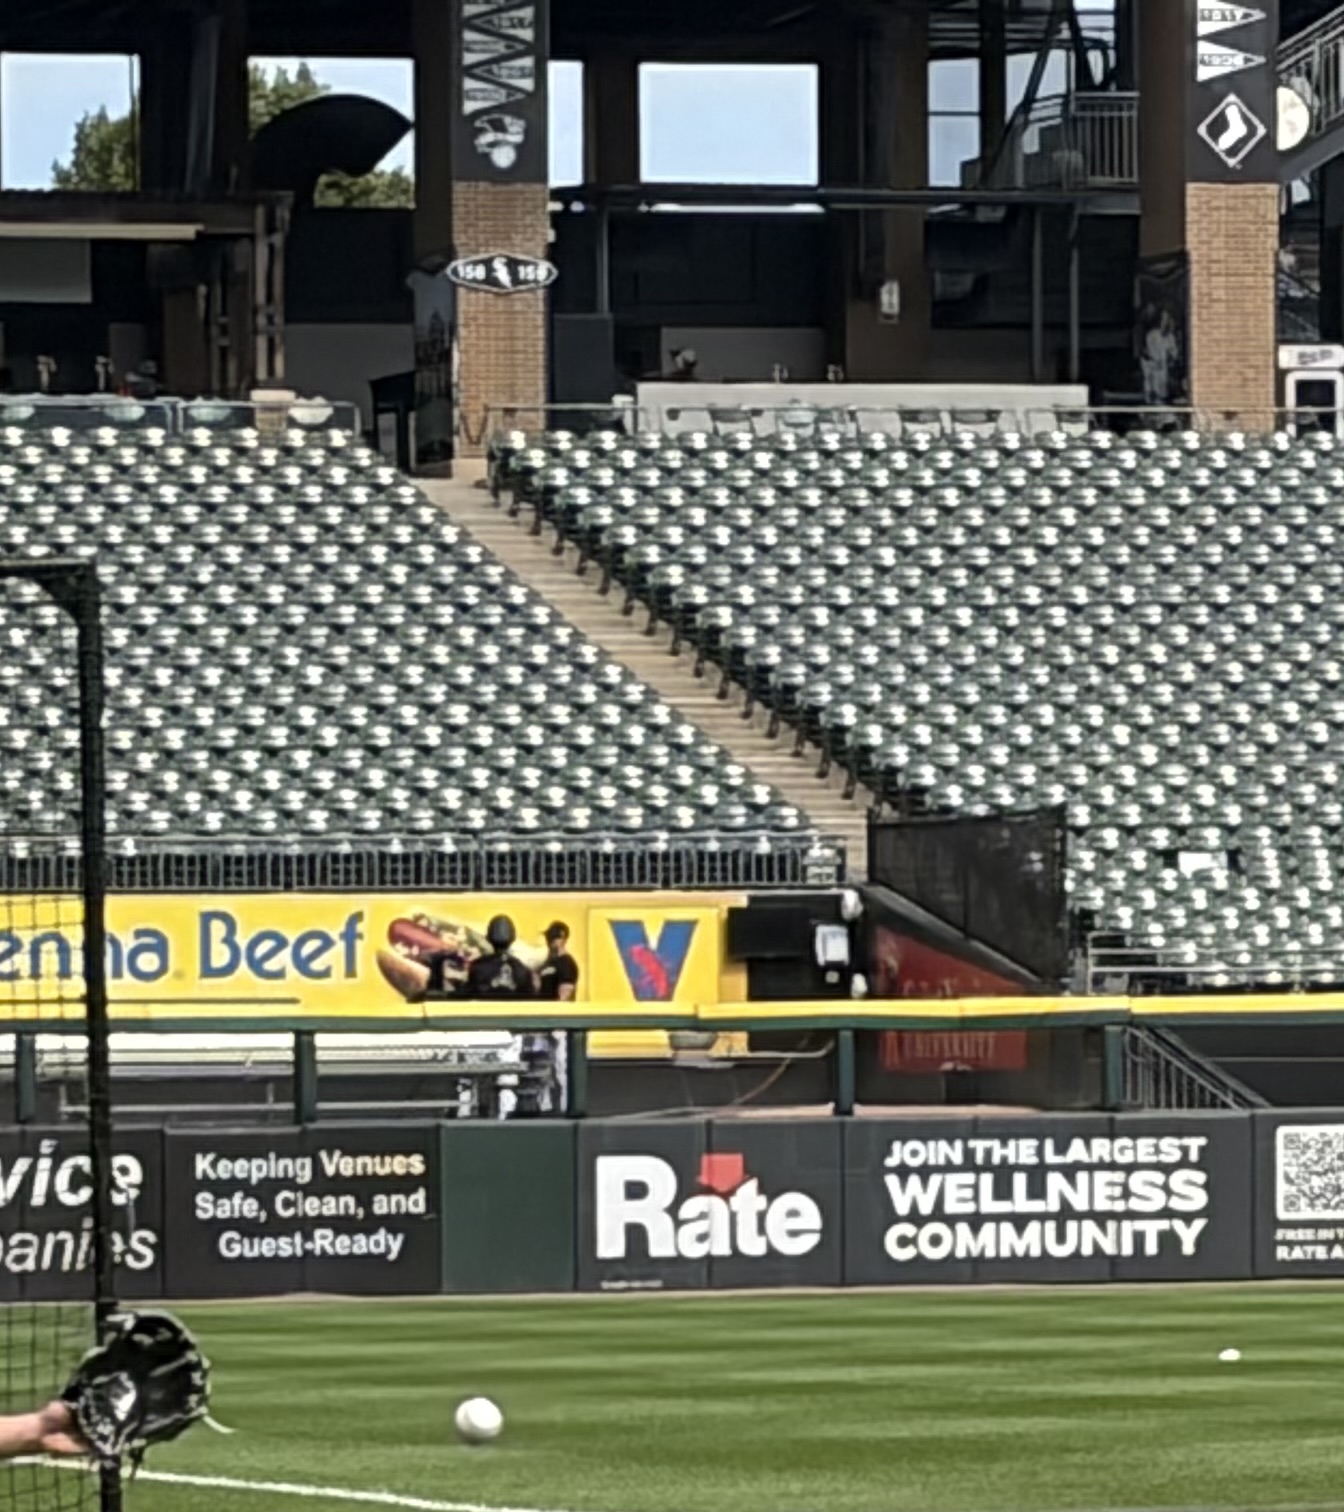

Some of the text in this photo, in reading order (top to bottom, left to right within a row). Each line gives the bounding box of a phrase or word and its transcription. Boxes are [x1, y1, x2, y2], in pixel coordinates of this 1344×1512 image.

[199, 910, 365, 981] Beef
[194, 1149, 427, 1185] Keeping Venues
[884, 1136, 1208, 1167] JOIN THE LARGEST
[194, 1187, 427, 1223] Safe, Clean, and
[595, 1155, 823, 1259] Rate
[884, 1169, 1209, 1216] WELLNESS
[218, 1227, 404, 1262] Guest-Ready
[883, 1217, 1209, 1262] COMMUNITY
[1276, 1245, 1329, 1261] RATE
